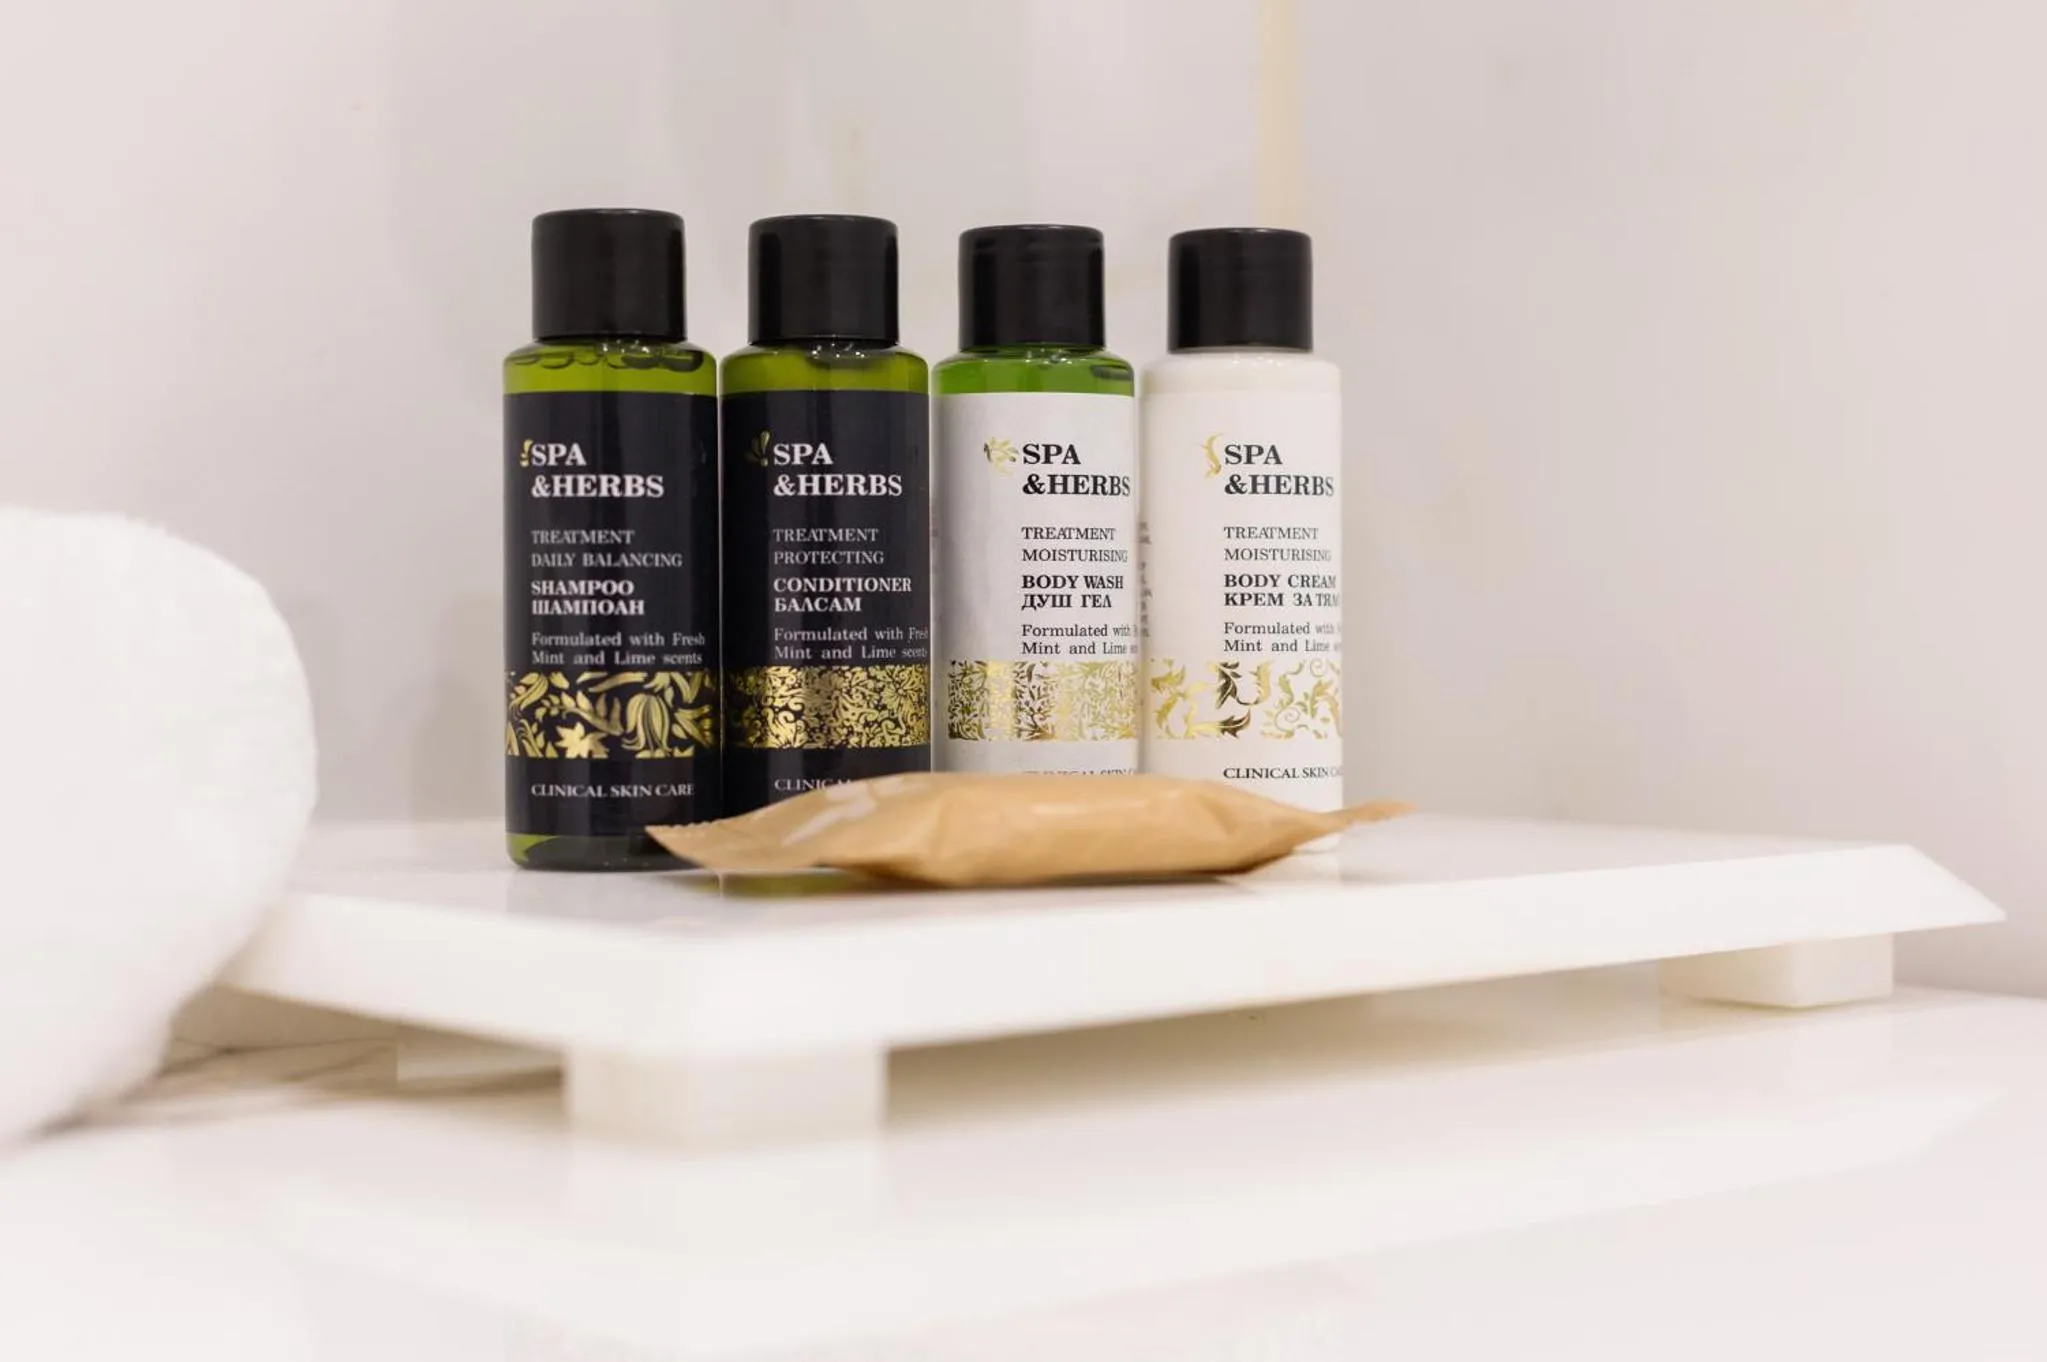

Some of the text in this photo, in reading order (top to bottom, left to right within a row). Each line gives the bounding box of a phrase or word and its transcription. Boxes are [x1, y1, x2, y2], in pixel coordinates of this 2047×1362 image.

[531, 443, 587, 466] SPA
[773, 443, 833, 466] SPA
[1022, 443, 1081, 465] SPA
[1224, 444, 1283, 465] SPA
[531, 474, 664, 498] &HERBS
[773, 474, 902, 497] &HERBS
[1022, 473, 1130, 497] &HERBS
[1224, 474, 1334, 497] &HERBS
[531, 530, 635, 545] TREATMENT
[773, 528, 878, 542] TREATMENT
[1022, 527, 1116, 540] TREATMENT
[1224, 526, 1319, 540] TREATMENT
[531, 553, 682, 567] DAILY BALANCING
[774, 551, 884, 565] PROTECTING
[1022, 549, 1128, 562] MOISTURISING
[1224, 548, 1332, 562] MOISTURISING
[531, 580, 634, 596] SHAMPOO
[773, 577, 912, 592] CONDITIONER
[1022, 575, 1123, 589] BODY WASH
[1224, 574, 1336, 589] BODY CREAM
[774, 597, 861, 612] БАЛСАМ
[1021, 594, 1112, 611] ДУШ ГЕЛ
[1224, 593, 1284, 607] КРЕМ
[1293, 593, 1312, 606] ЗА
[531, 599, 645, 616] ШАМПОАН
[774, 627, 867, 641] Formulated
[875, 627, 903, 641] with
[1022, 625, 1108, 637] Formulated
[1224, 622, 1310, 635] Formulated
[531, 632, 705, 647] Formulated with Fresh
[1224, 640, 1262, 652] Mint
[1271, 640, 1298, 652] and
[1305, 640, 1329, 652] Lime
[774, 646, 812, 659] Mint
[821, 646, 852, 659] and
[861, 647, 896, 659] Lime
[1022, 642, 1060, 655] Mint
[1069, 642, 1096, 655] and
[1102, 642, 1127, 654] Lime
[532, 651, 703, 665] Mint and Lime scents
[1223, 768, 1299, 779] CLINICAL
[1302, 766, 1328, 778] SKIN
[531, 783, 696, 798] CLINICAL SKIN CARE
[774, 778, 851, 791] CLINIC
